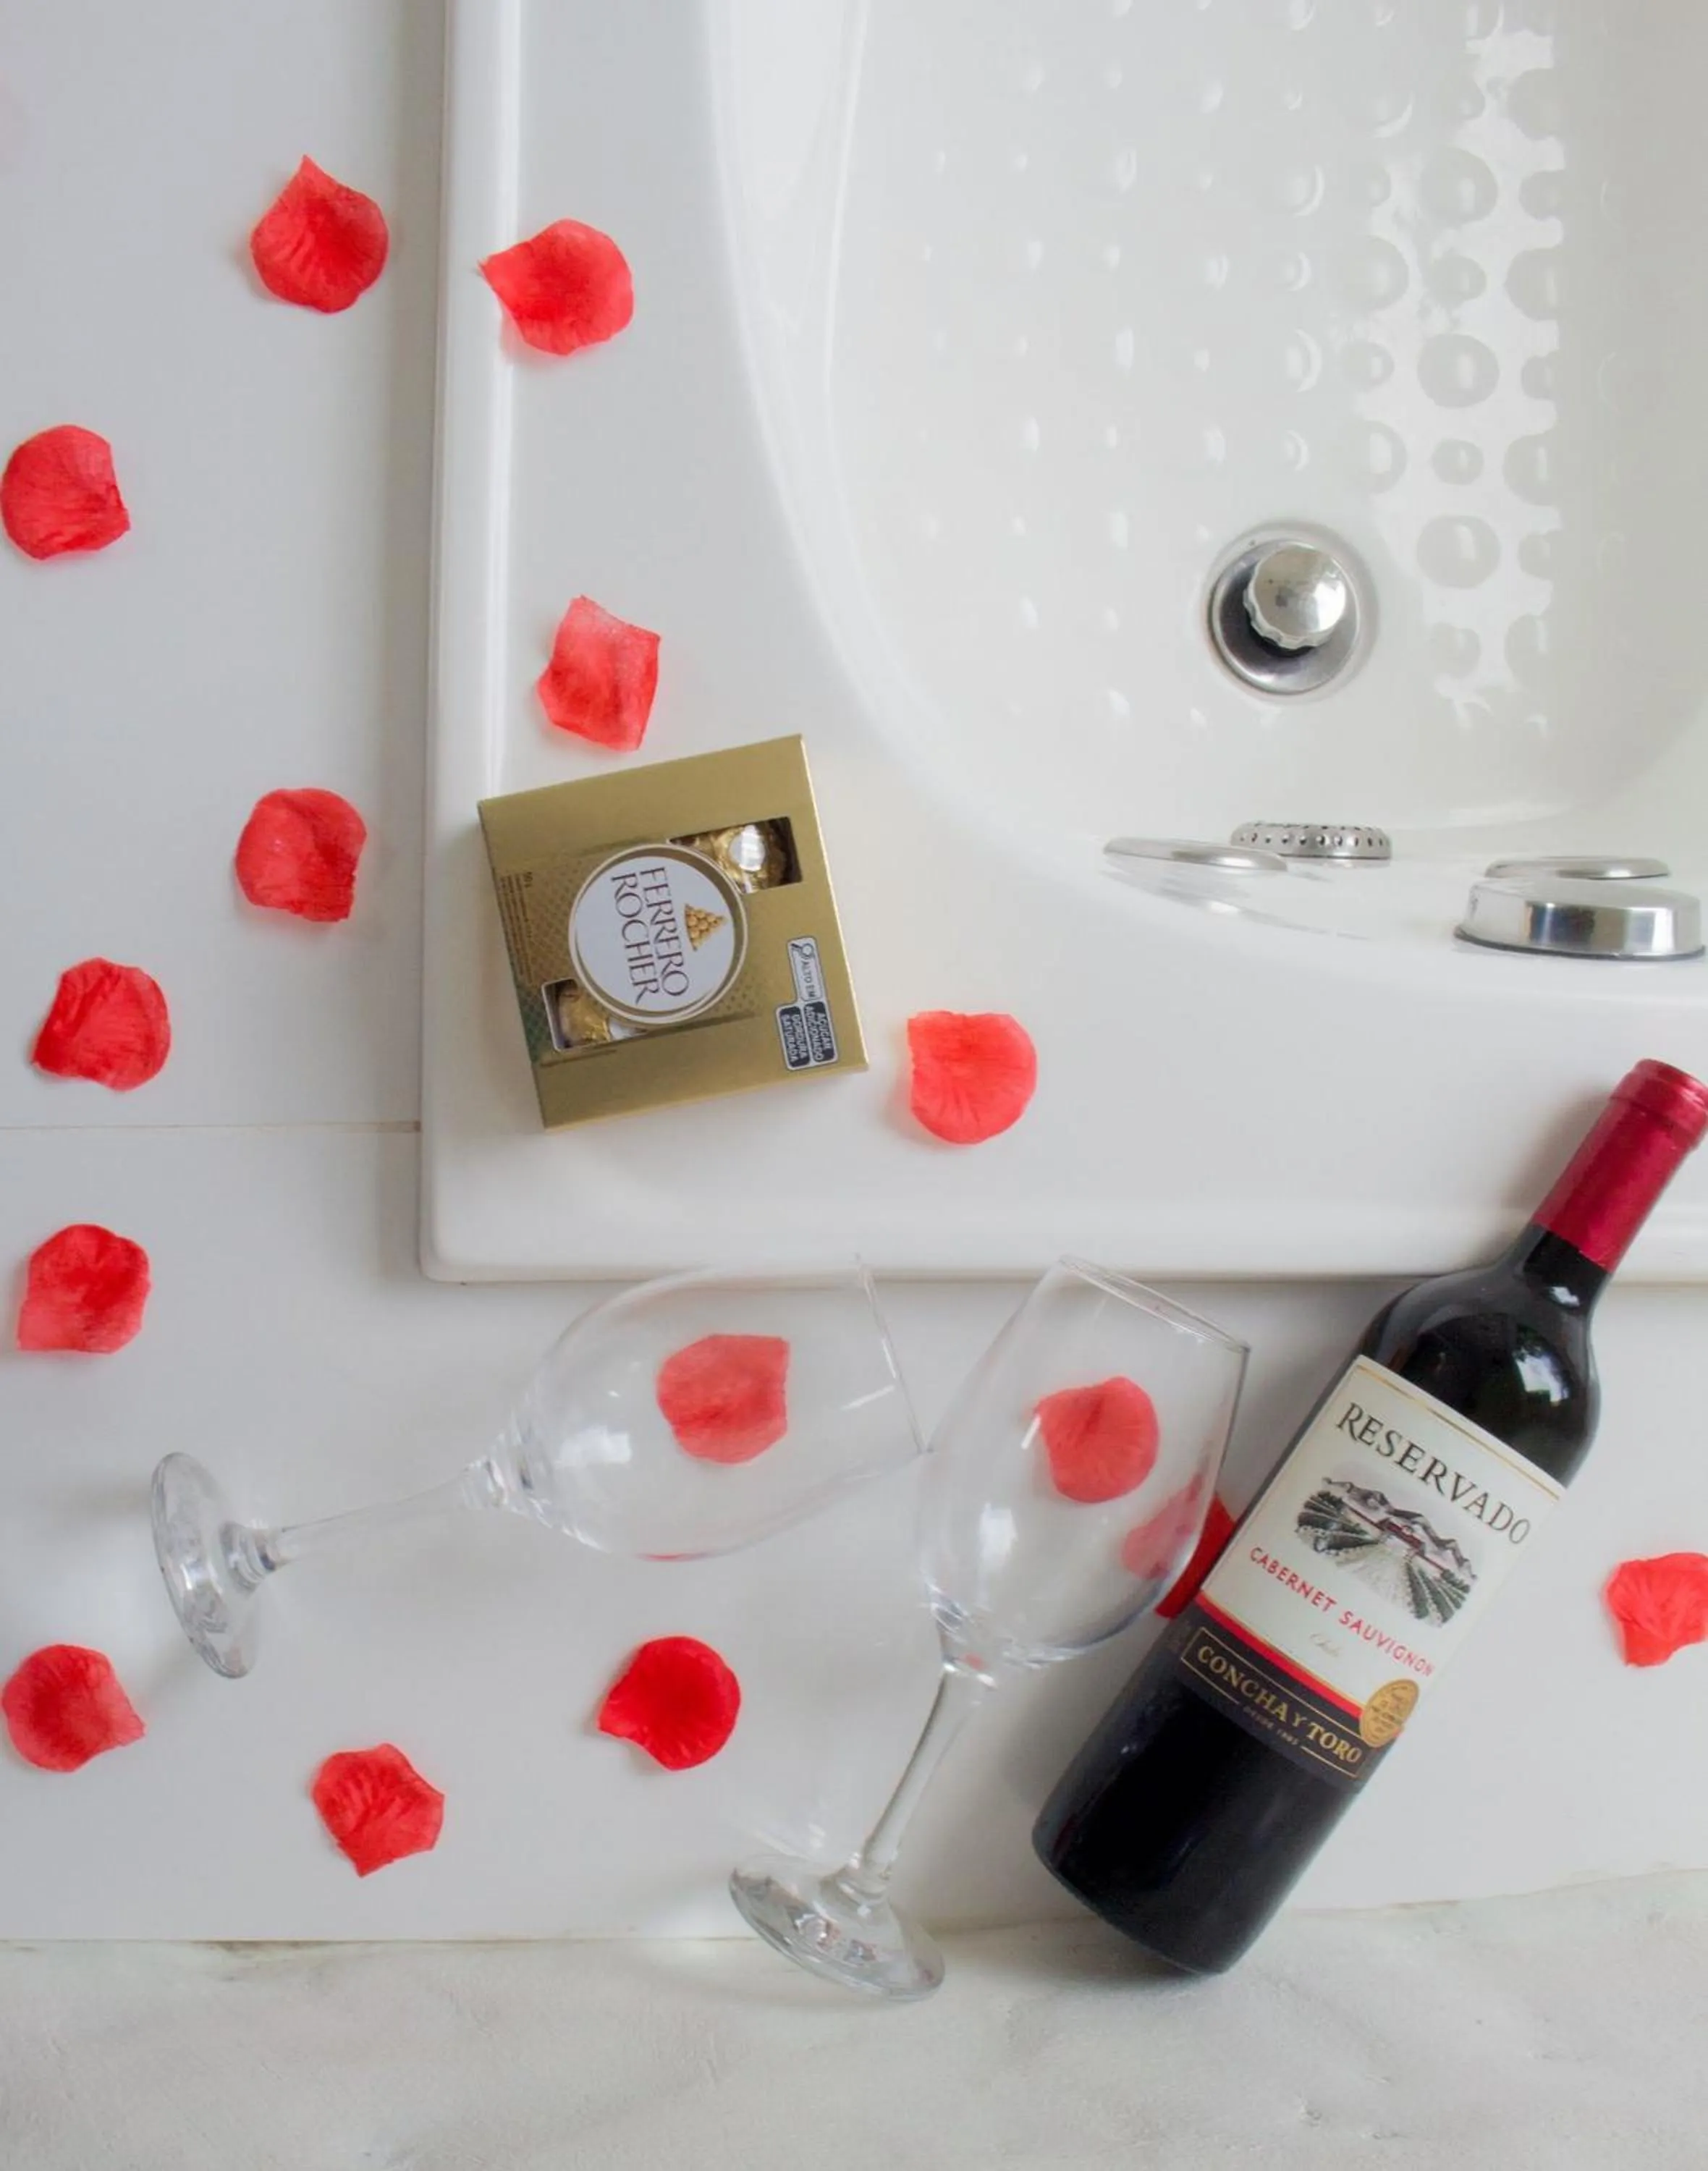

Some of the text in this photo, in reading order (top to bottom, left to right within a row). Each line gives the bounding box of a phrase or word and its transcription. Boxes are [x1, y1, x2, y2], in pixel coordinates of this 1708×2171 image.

[611, 873, 660, 1005] ROCHER
[640, 867, 690, 996] FERRERO
[800, 960, 816, 998] ALTO EM
[805, 1004, 824, 1061] ADICIONADO
[1336, 1402, 1532, 1544] RESERVADO
[1250, 1546, 1434, 1677] CABERNET SAUVIGNON
[1197, 1645, 1363, 1763] CONCHA Y TORO
